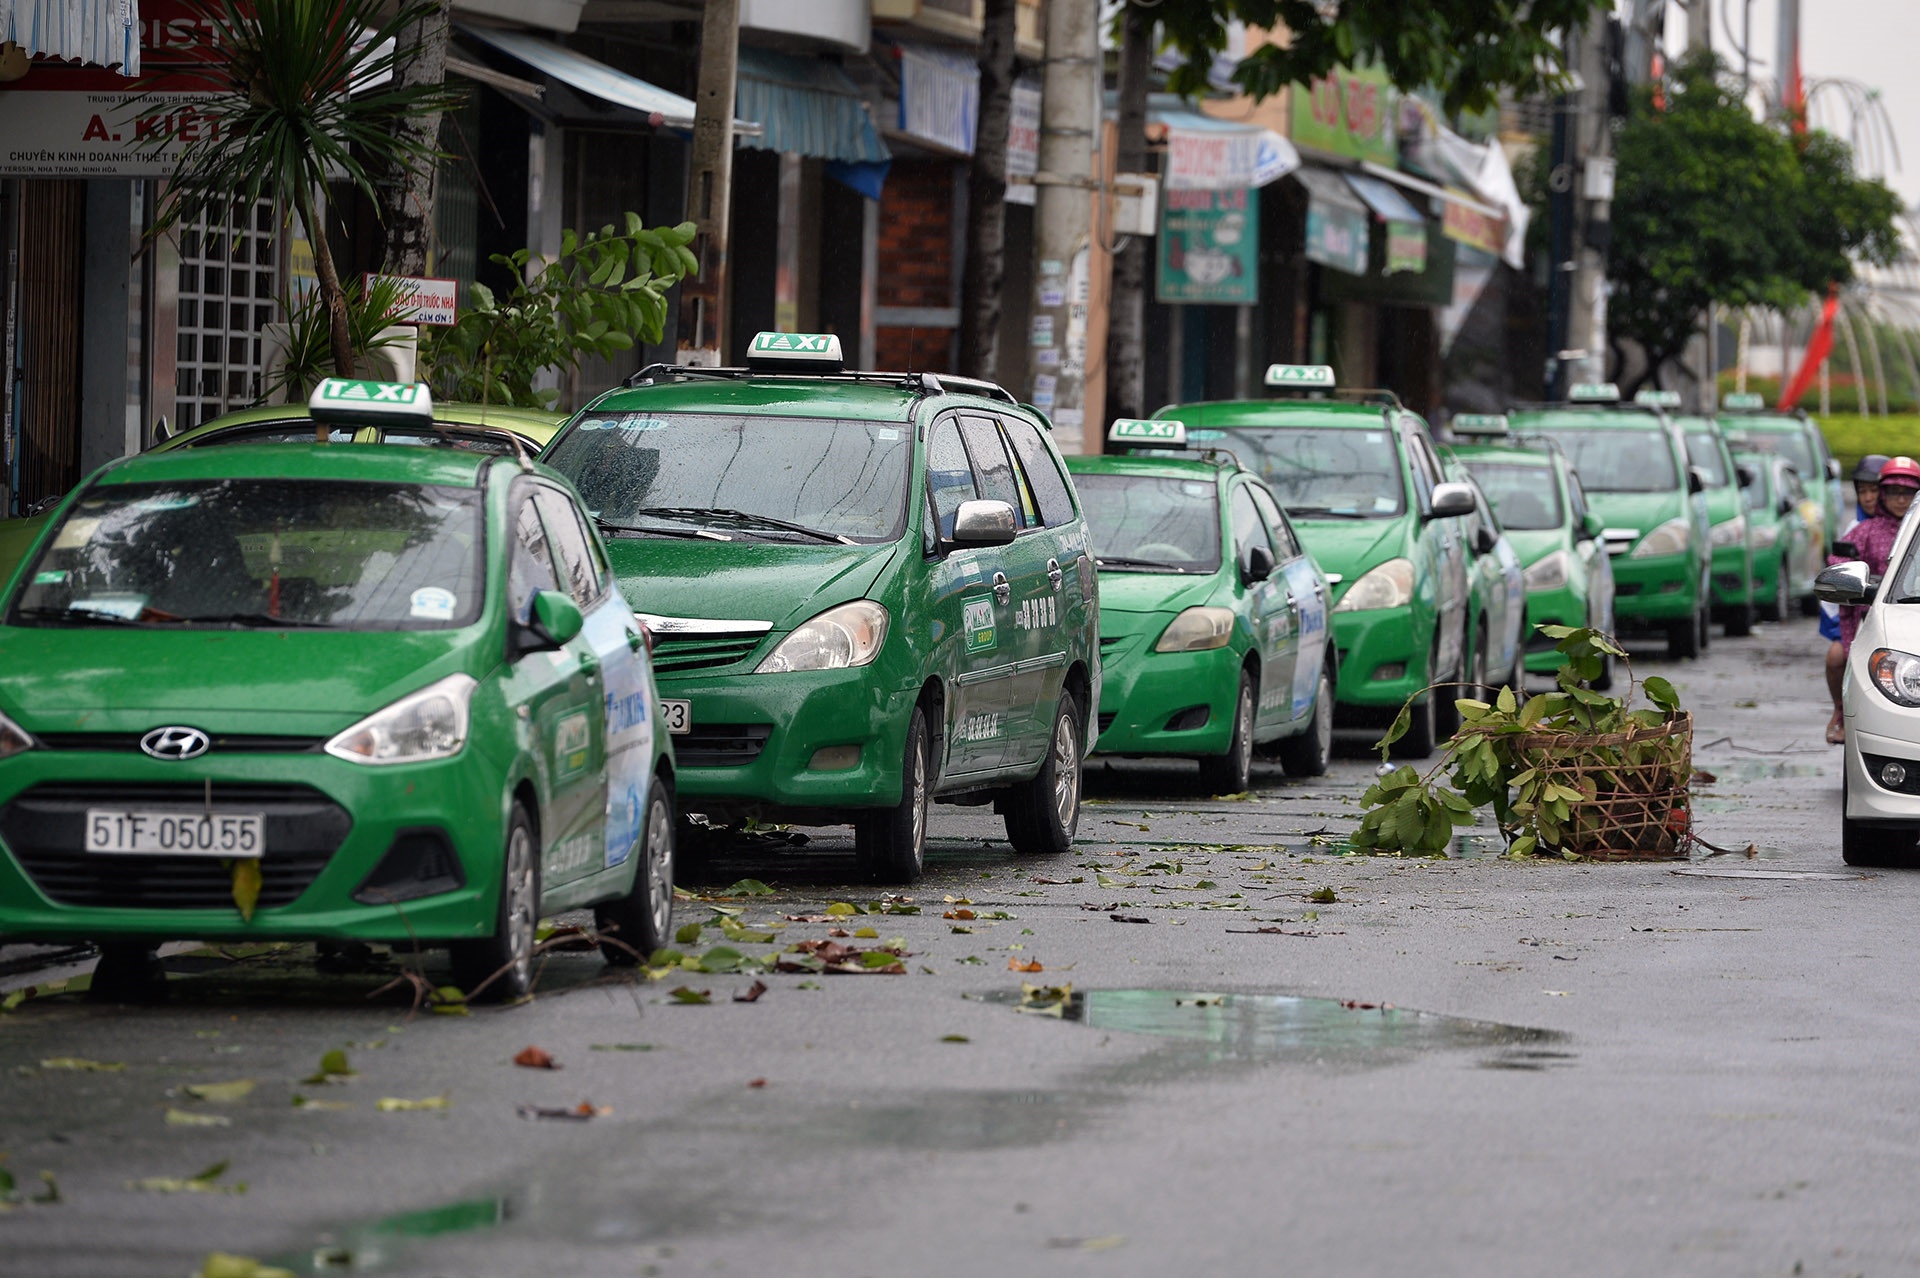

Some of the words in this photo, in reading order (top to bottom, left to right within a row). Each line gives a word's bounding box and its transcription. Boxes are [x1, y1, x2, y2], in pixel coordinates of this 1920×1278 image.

[88, 96, 116, 104] TRUNG
[82, 114, 121, 141] A.
[10, 149, 55, 162] CHUYÊN
[58, 152, 86, 162] KINH
[977, 631, 992, 643] GROUP
[93, 816, 256, 851] 51F-050.55
